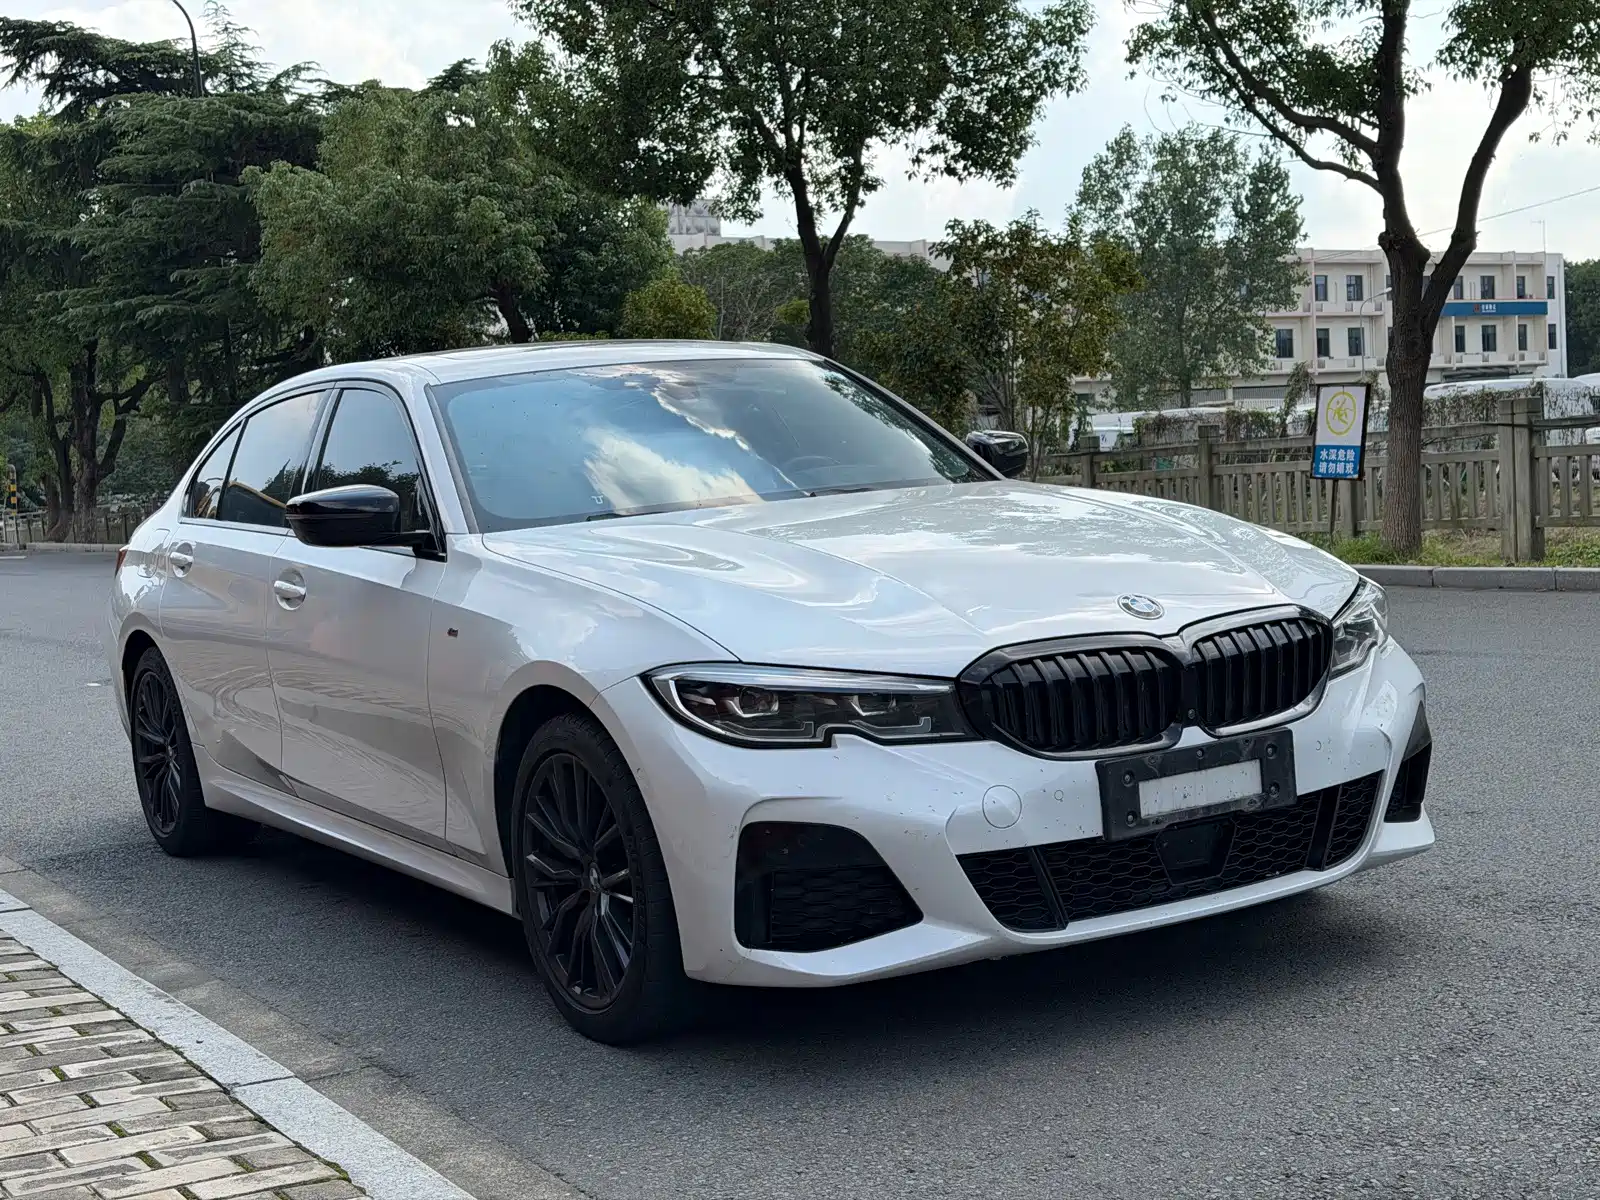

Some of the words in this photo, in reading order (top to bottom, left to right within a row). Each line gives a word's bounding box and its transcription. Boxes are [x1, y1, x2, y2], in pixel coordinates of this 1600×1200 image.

[1319, 448, 1356, 461] 水深危险
[1318, 461, 1354, 475] 请勿嬉戏
